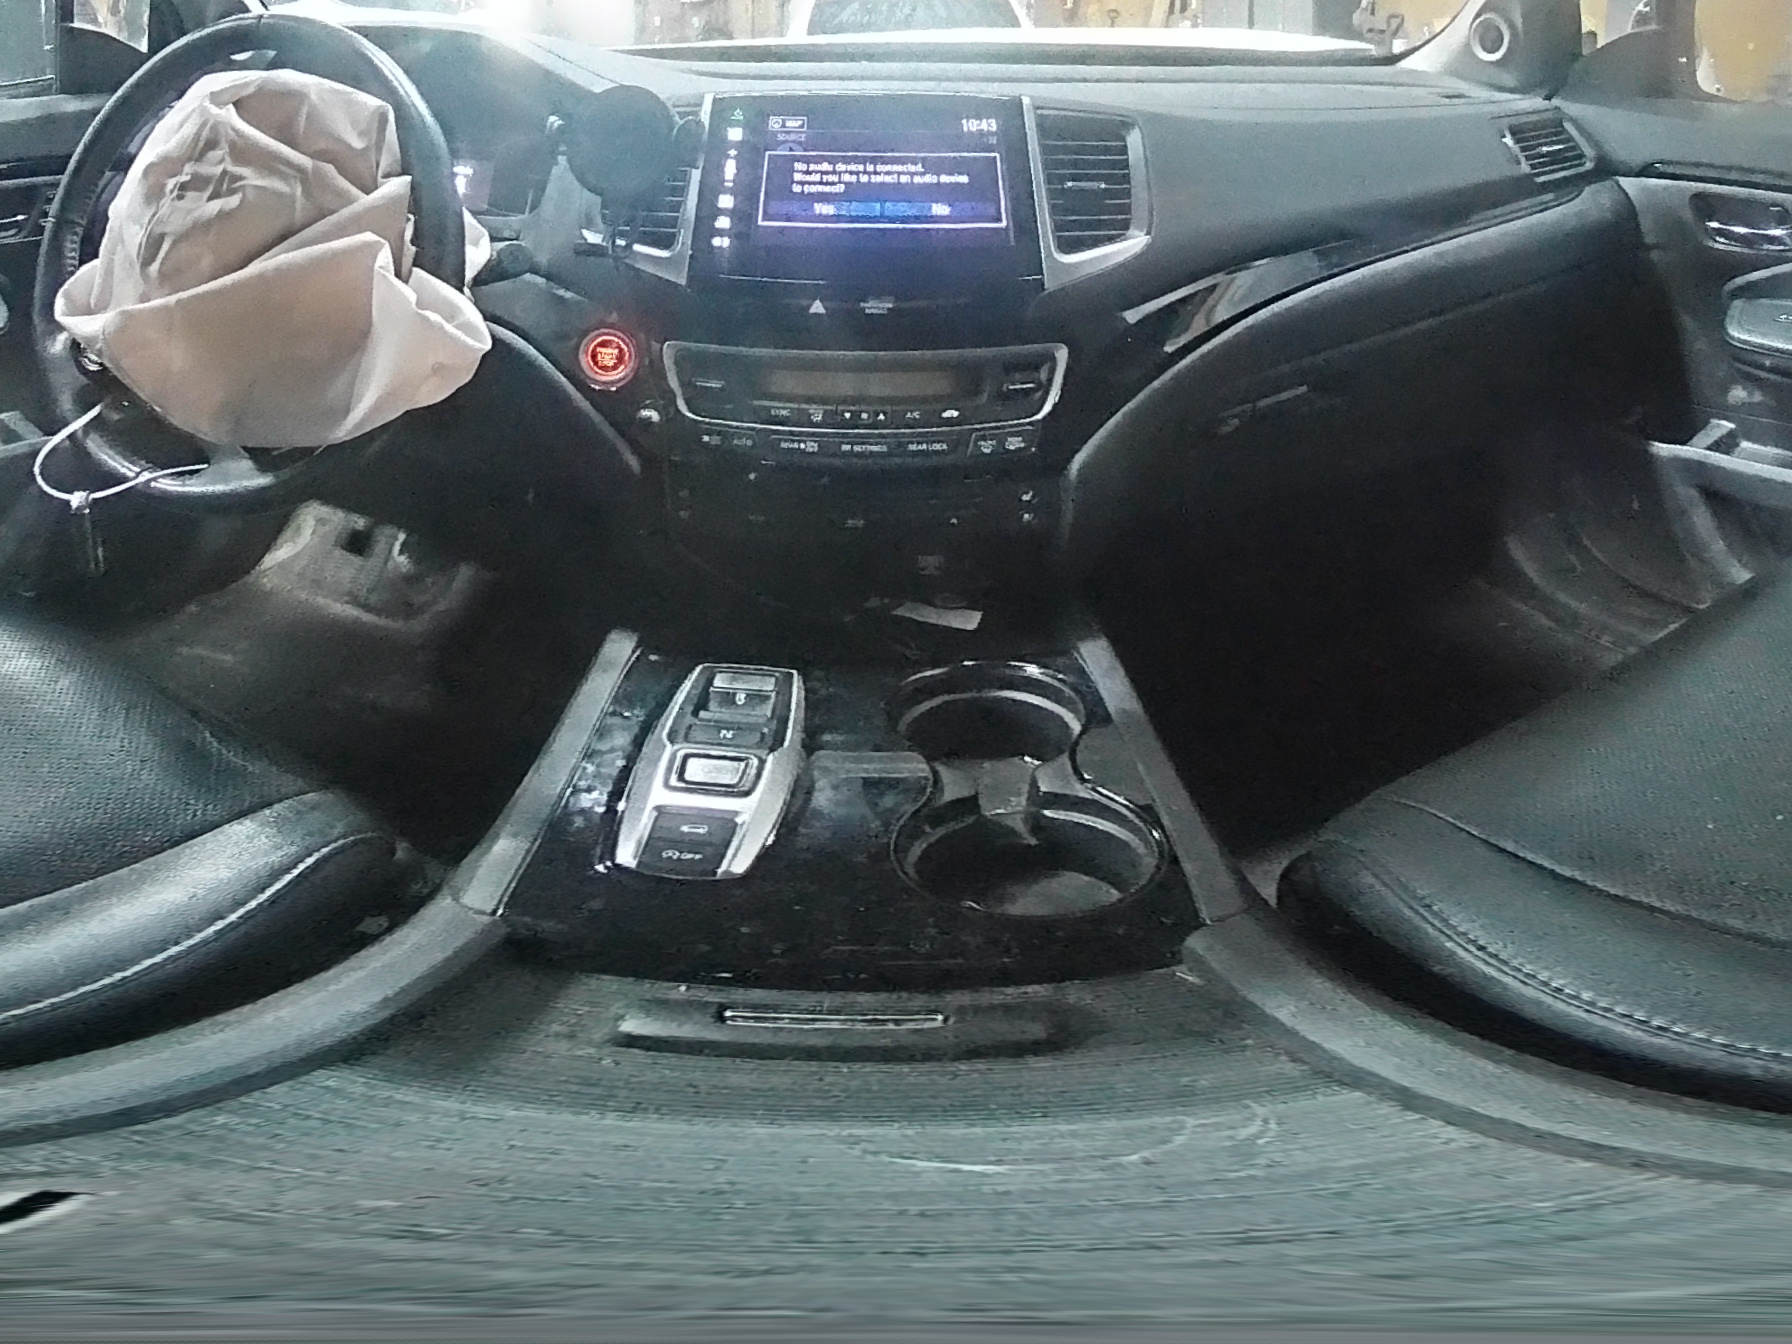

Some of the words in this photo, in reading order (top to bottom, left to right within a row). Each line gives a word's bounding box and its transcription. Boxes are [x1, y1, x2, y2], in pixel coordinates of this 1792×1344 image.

[961, 118, 997, 132] 10:43
[794, 162, 808, 172] No
[835, 162, 865, 172] device
[866, 162, 875, 172] is
[876, 162, 925, 172] connected.
[793, 172, 821, 182] Would
[822, 173, 839, 184] you
[841, 172, 858, 183] like
[859, 173, 870, 183] to
[870, 173, 899, 183] select
[913, 173, 939, 184] audio
[792, 183, 802, 193] to
[803, 183, 846, 194] connect?
[813, 203, 835, 216] Yes
[931, 203, 950, 216] No
